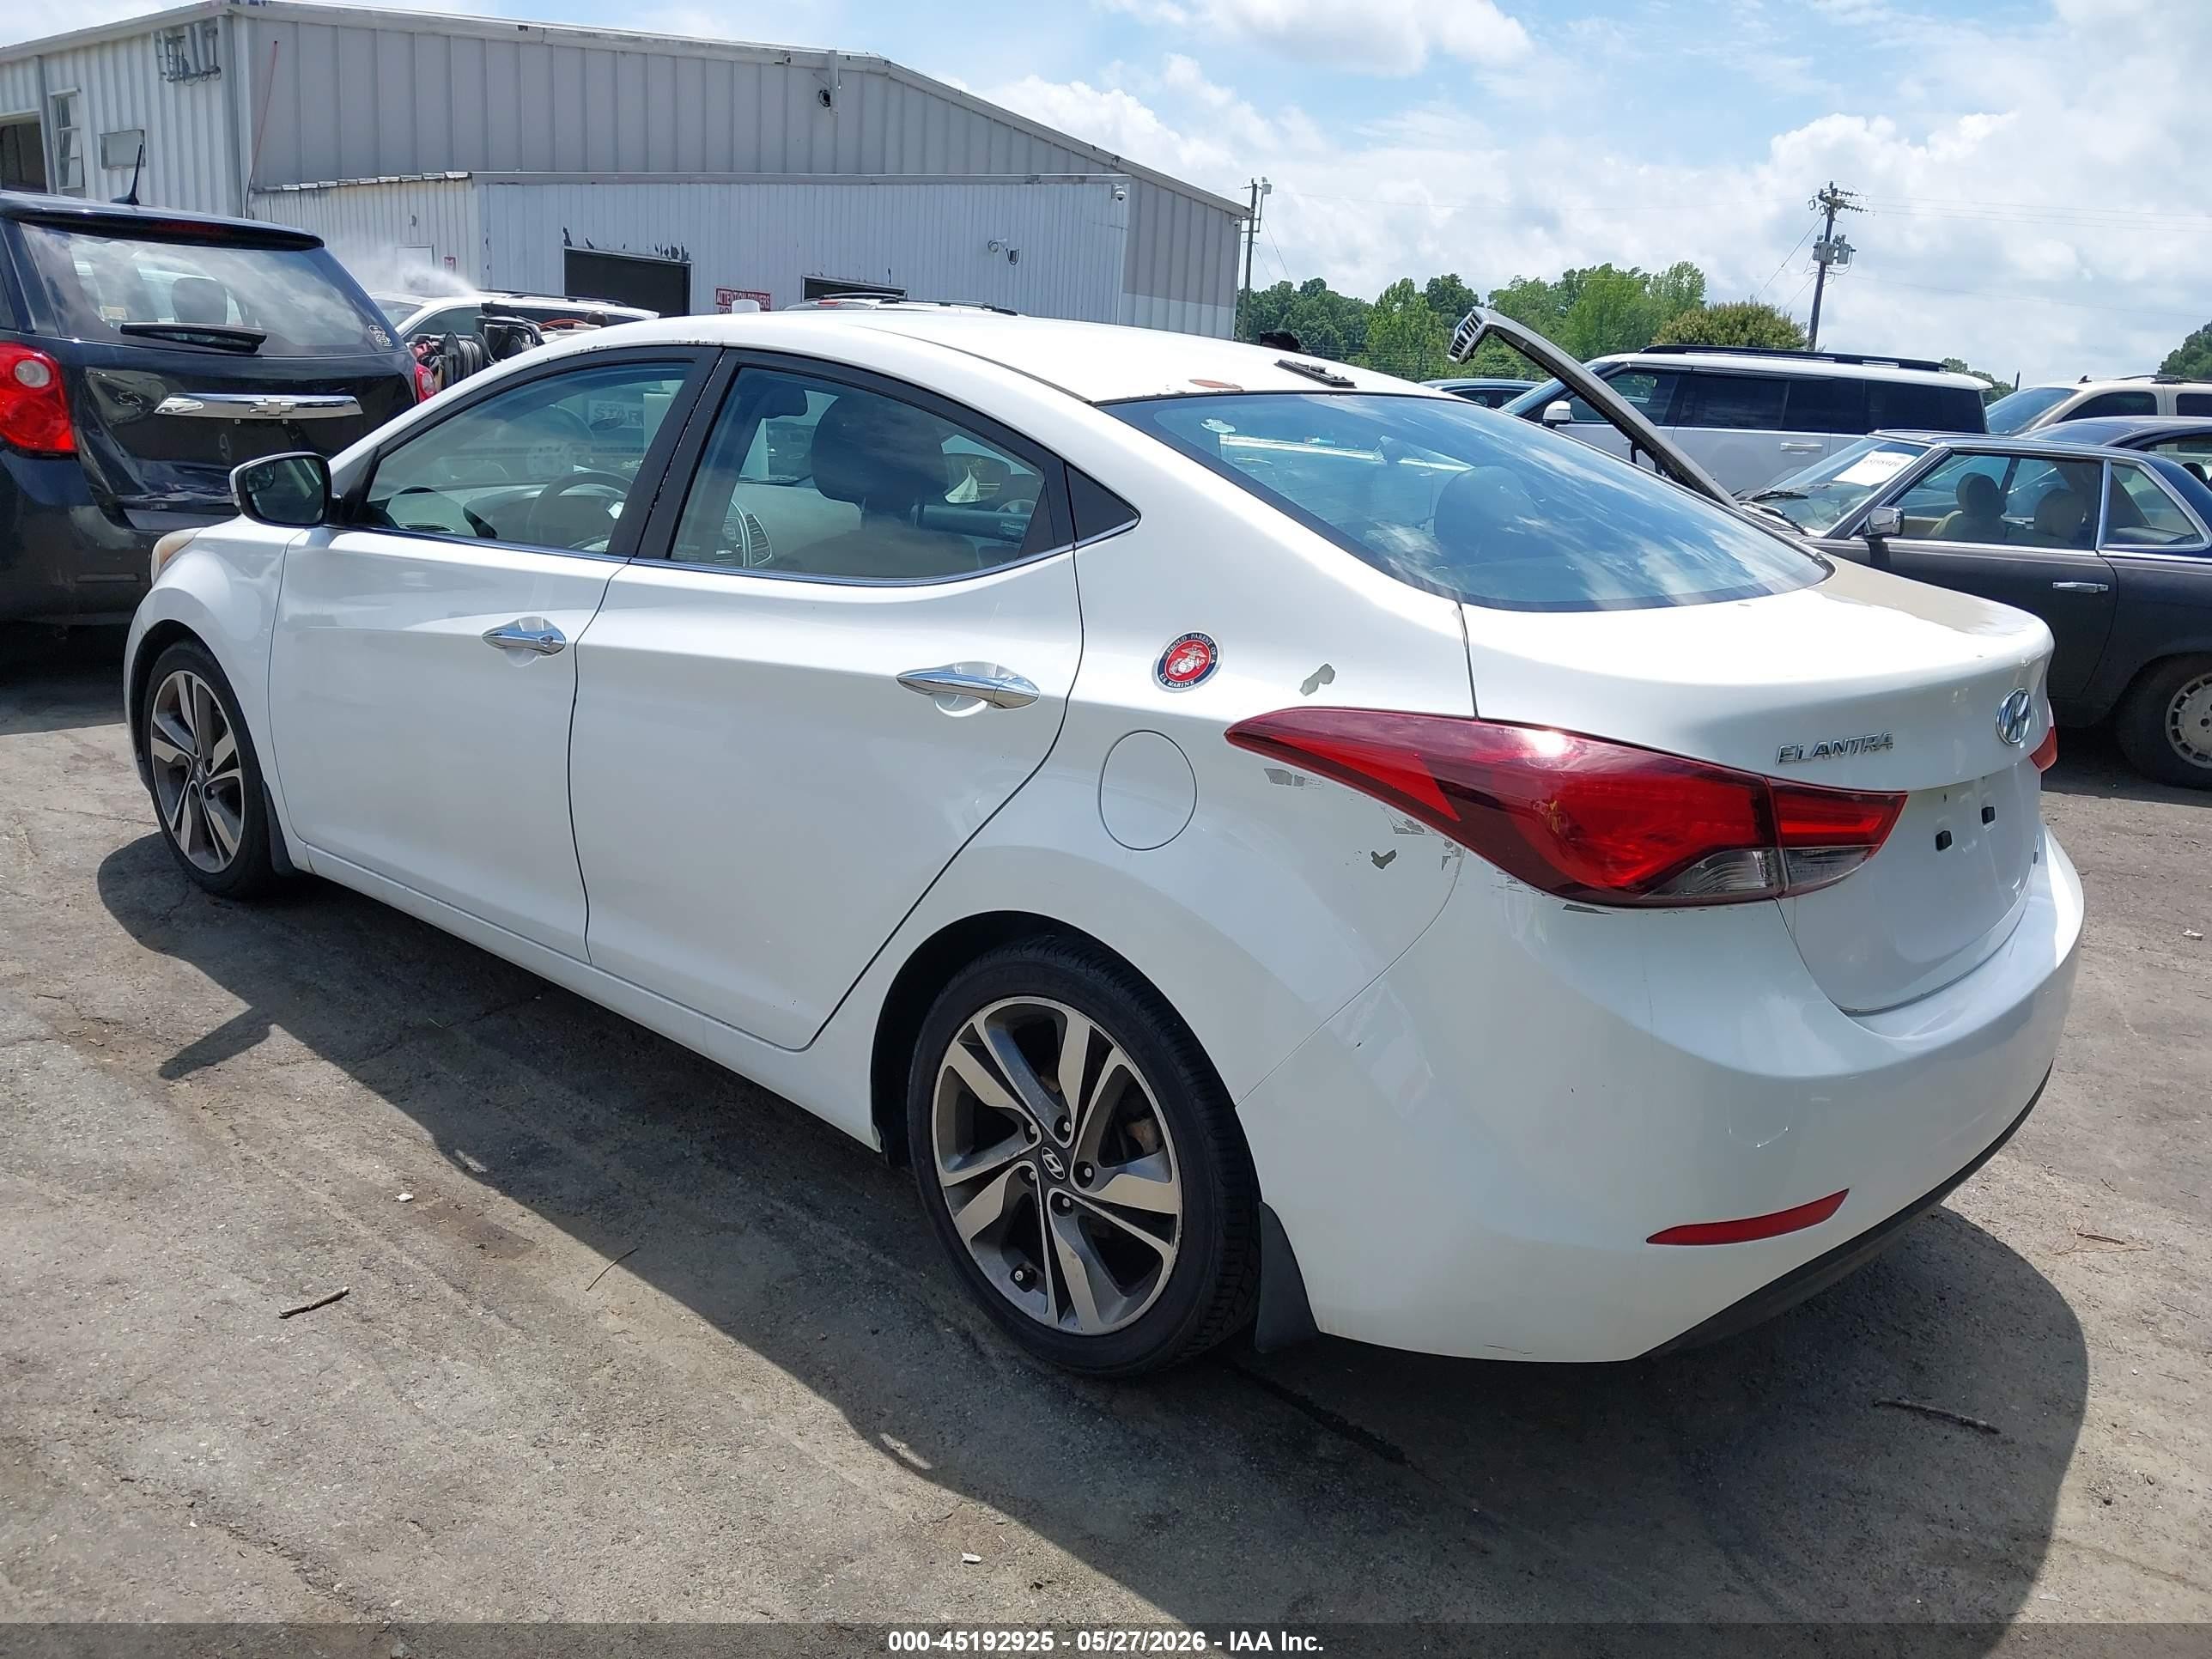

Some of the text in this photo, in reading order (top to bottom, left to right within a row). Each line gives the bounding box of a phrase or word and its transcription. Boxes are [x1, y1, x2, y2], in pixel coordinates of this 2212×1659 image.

[1167, 635, 1188, 653] PROUD
[1190, 633, 1213, 646] PARENT
[1168, 679, 1195, 688] MARINE
[1777, 732, 1894, 765] ELANTRA
